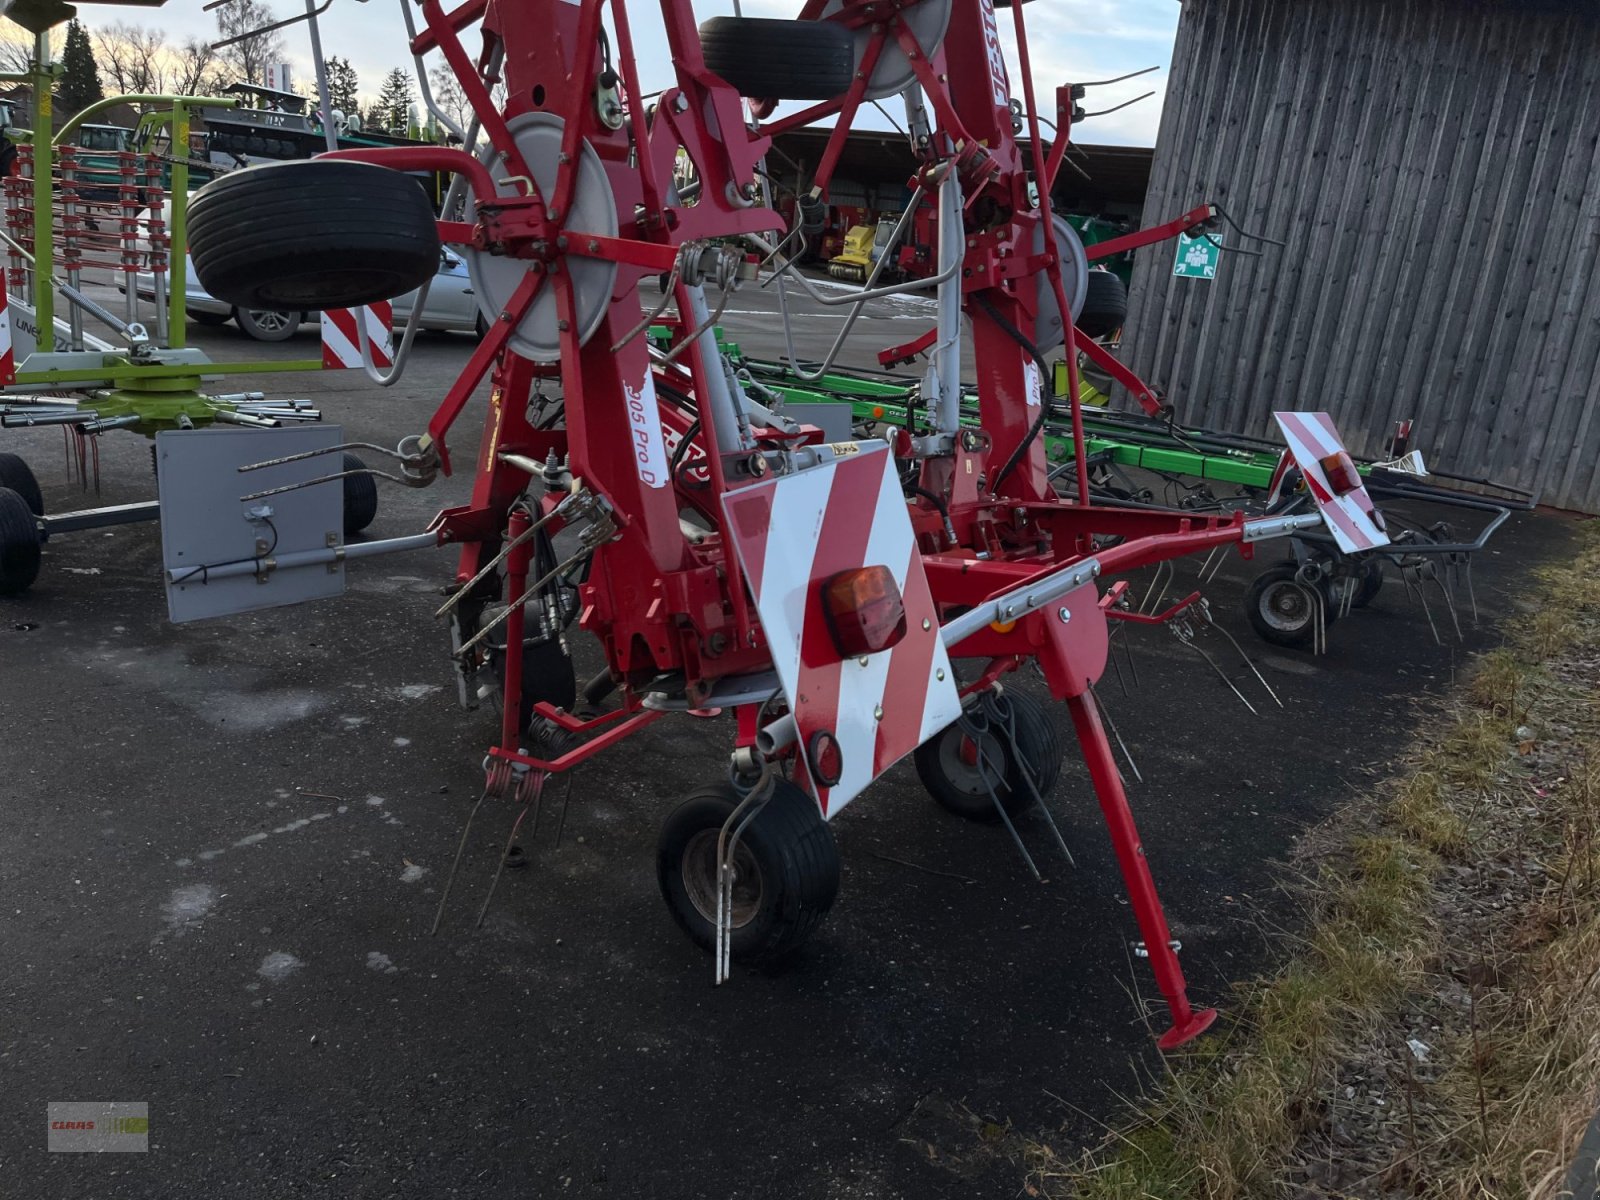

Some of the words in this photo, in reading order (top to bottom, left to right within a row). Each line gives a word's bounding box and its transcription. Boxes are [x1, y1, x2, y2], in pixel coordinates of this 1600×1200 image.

[1031, 376, 1039, 400] Pro
[634, 428, 649, 464] Pro
[640, 469, 656, 485] D
